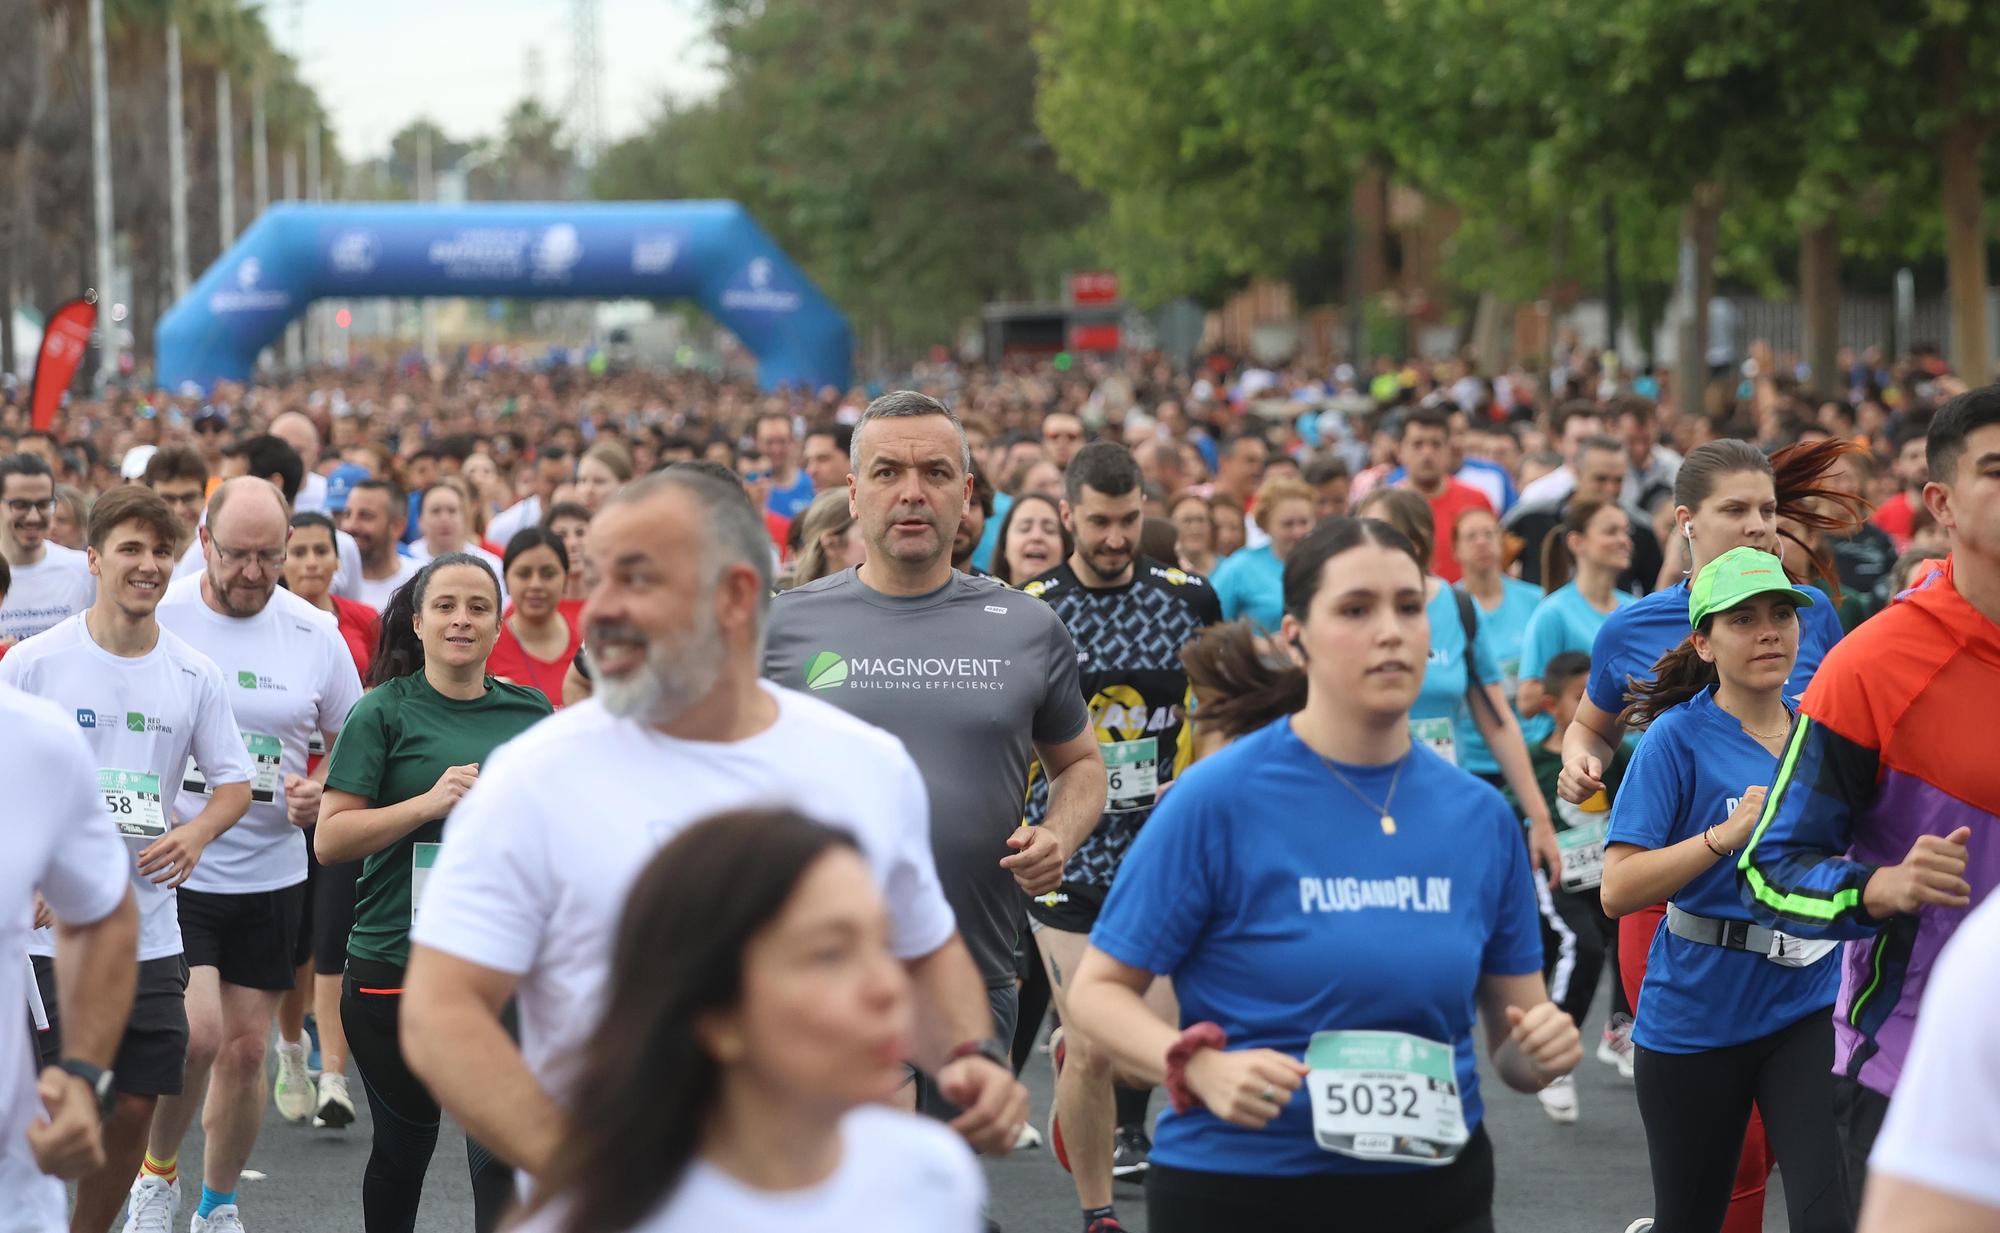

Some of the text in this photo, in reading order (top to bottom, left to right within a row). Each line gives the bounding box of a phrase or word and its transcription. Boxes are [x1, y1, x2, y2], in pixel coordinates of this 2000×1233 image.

[851, 658, 1001, 676] MAGNOVENT
[851, 681, 1004, 690] BUILDING EFFICIENCY
[80, 713, 95, 723] LTL
[147, 724, 173, 734] CONTROL
[1299, 876, 1451, 913] PLUGANDPLAY
[1327, 1082, 1420, 1119] 5032
